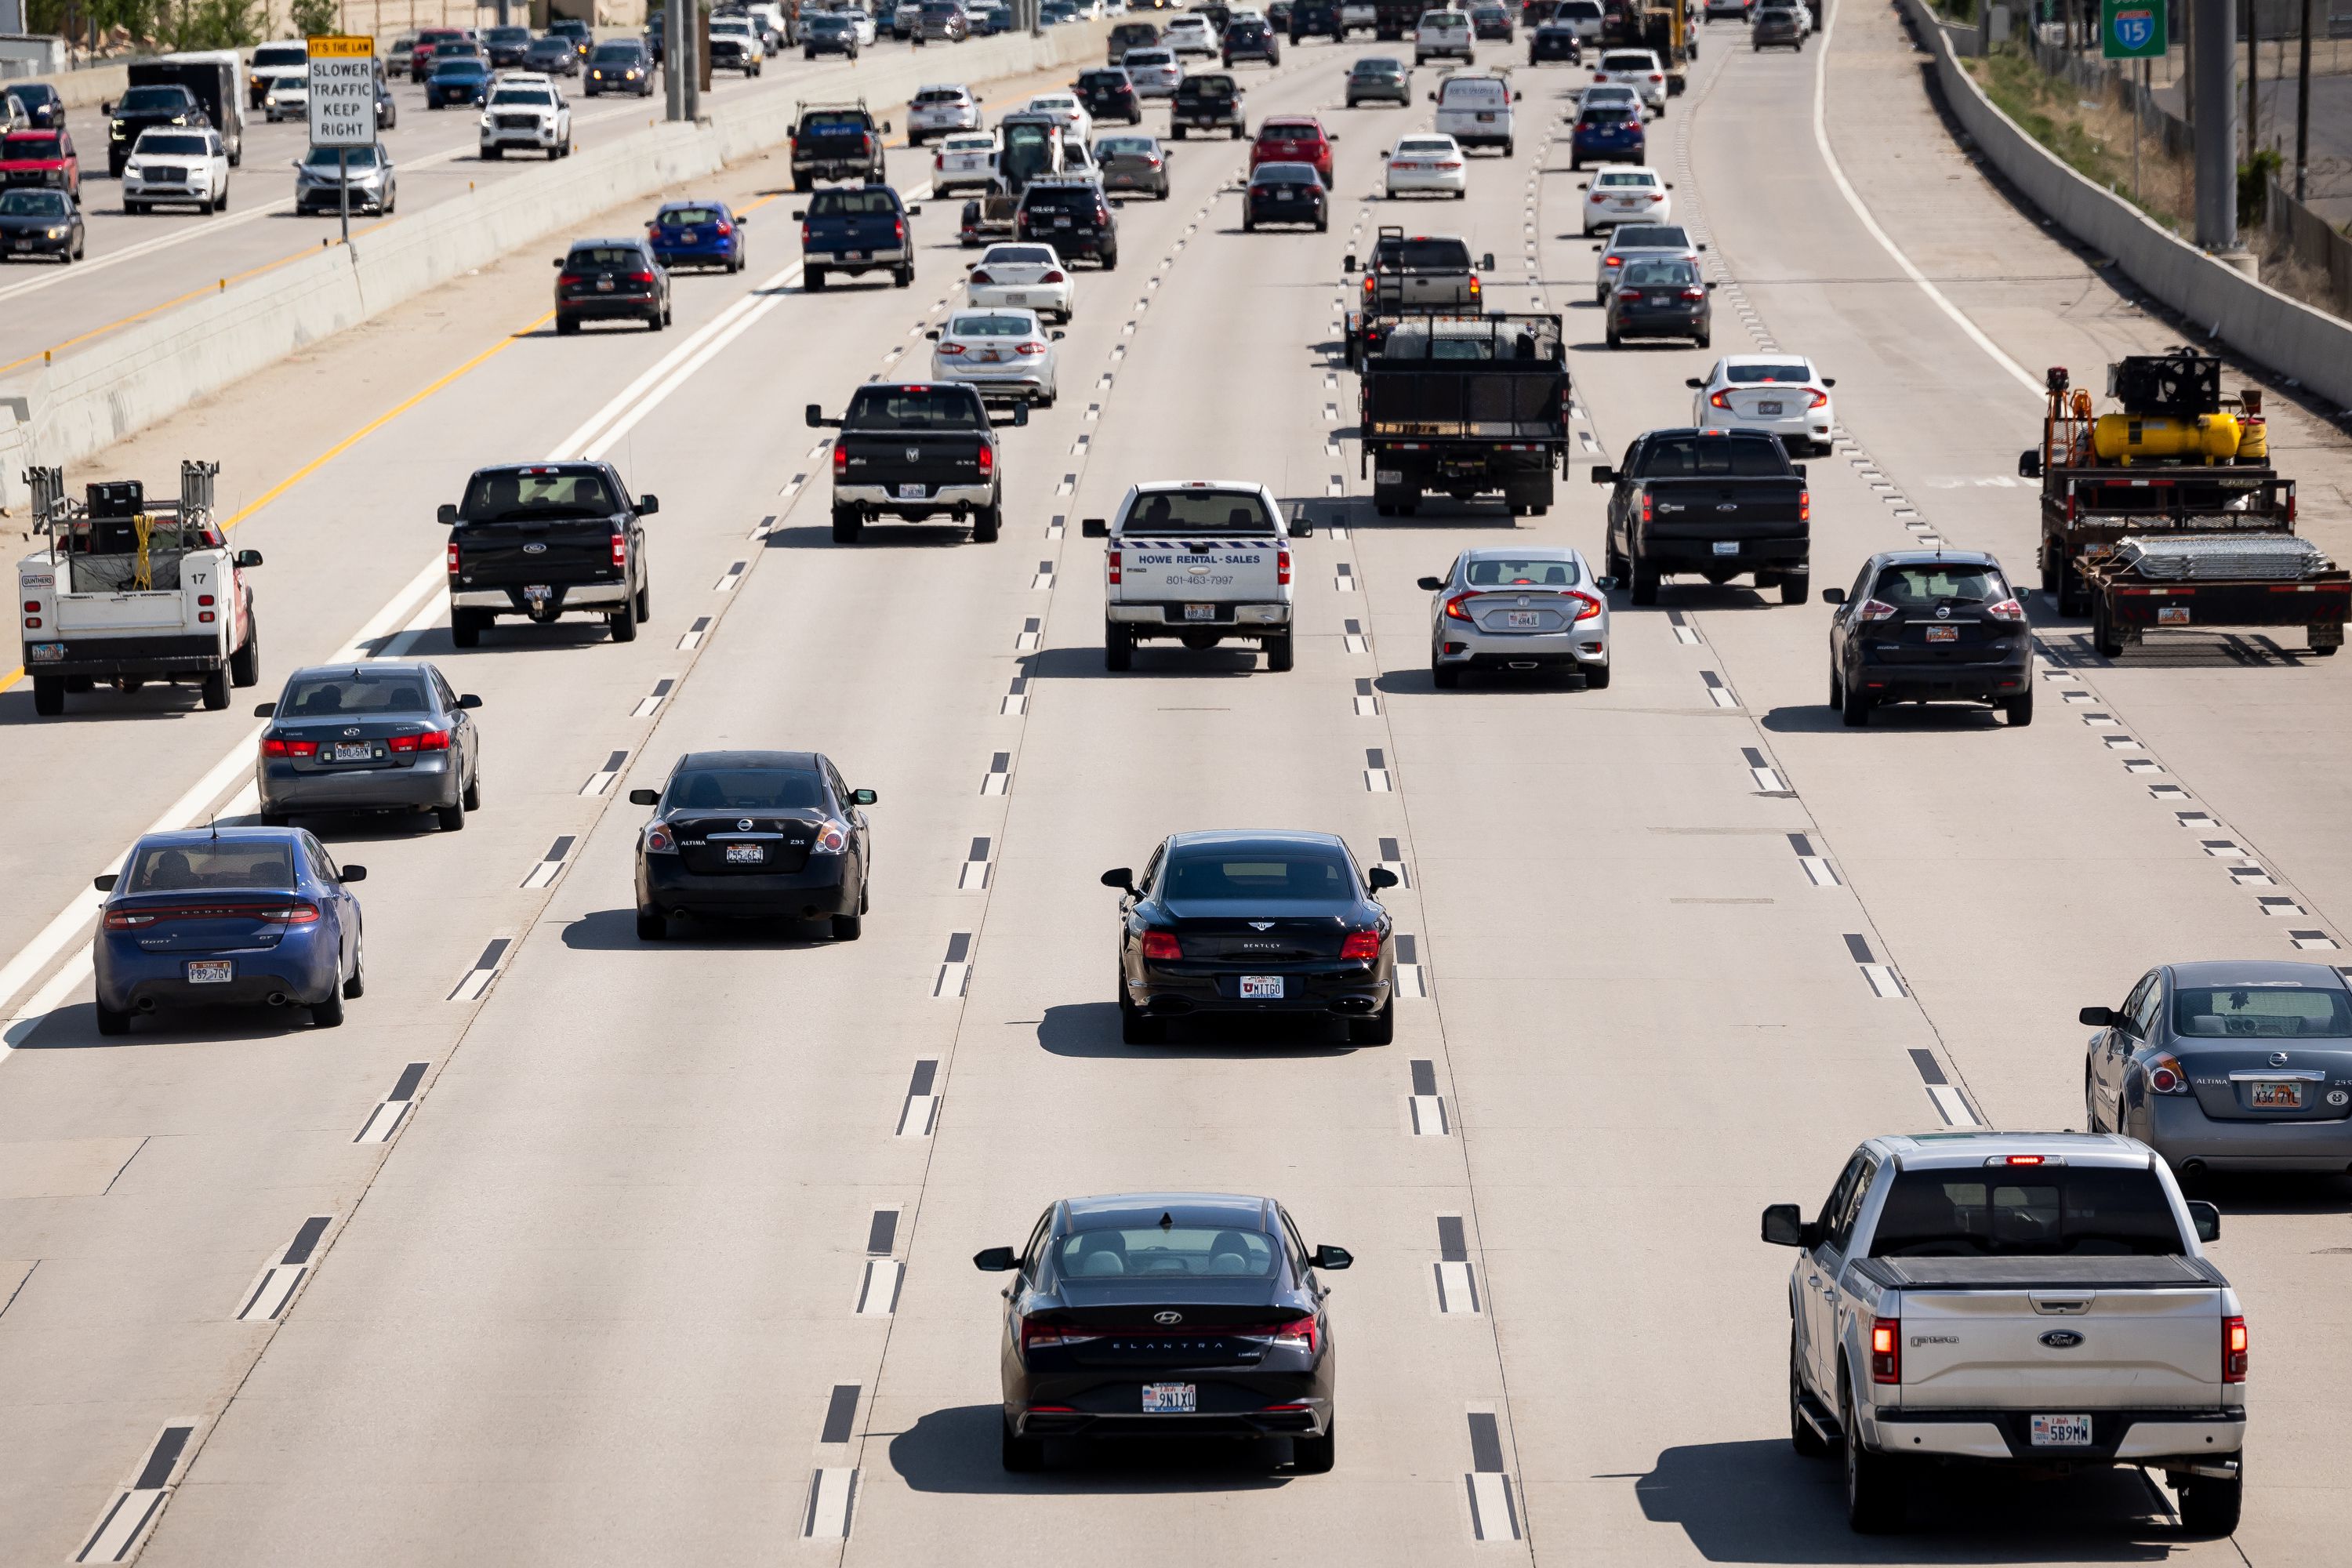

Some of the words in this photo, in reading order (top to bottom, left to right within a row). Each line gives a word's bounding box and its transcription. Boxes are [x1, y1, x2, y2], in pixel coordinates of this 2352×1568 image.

[2123, 22, 2146, 42] 15
[310, 43, 328, 53] IT'S
[333, 43, 348, 53] THE
[351, 43, 369, 53] LAW
[313, 63, 369, 77] SLOWER
[312, 82, 371, 96] TRAFFIC
[323, 102, 360, 117] KEEP
[321, 122, 363, 136] RIGHT
[1139, 555, 1172, 564] HOWE
[1177, 555, 1218, 564] RENTAL
[1225, 555, 1260, 564] SALES
[24, 577, 53, 586] GUNTHERS
[191, 573, 206, 585] 17
[1166, 575, 1233, 585] 801-463-7997
[191, 968, 207, 979] F89
[2256, 1091, 2273, 1103] X36
[2280, 1091, 2298, 1104] 7YL
[2049, 1334, 2074, 1345] Ford
[1159, 1392, 1195, 1407] 9N1XU
